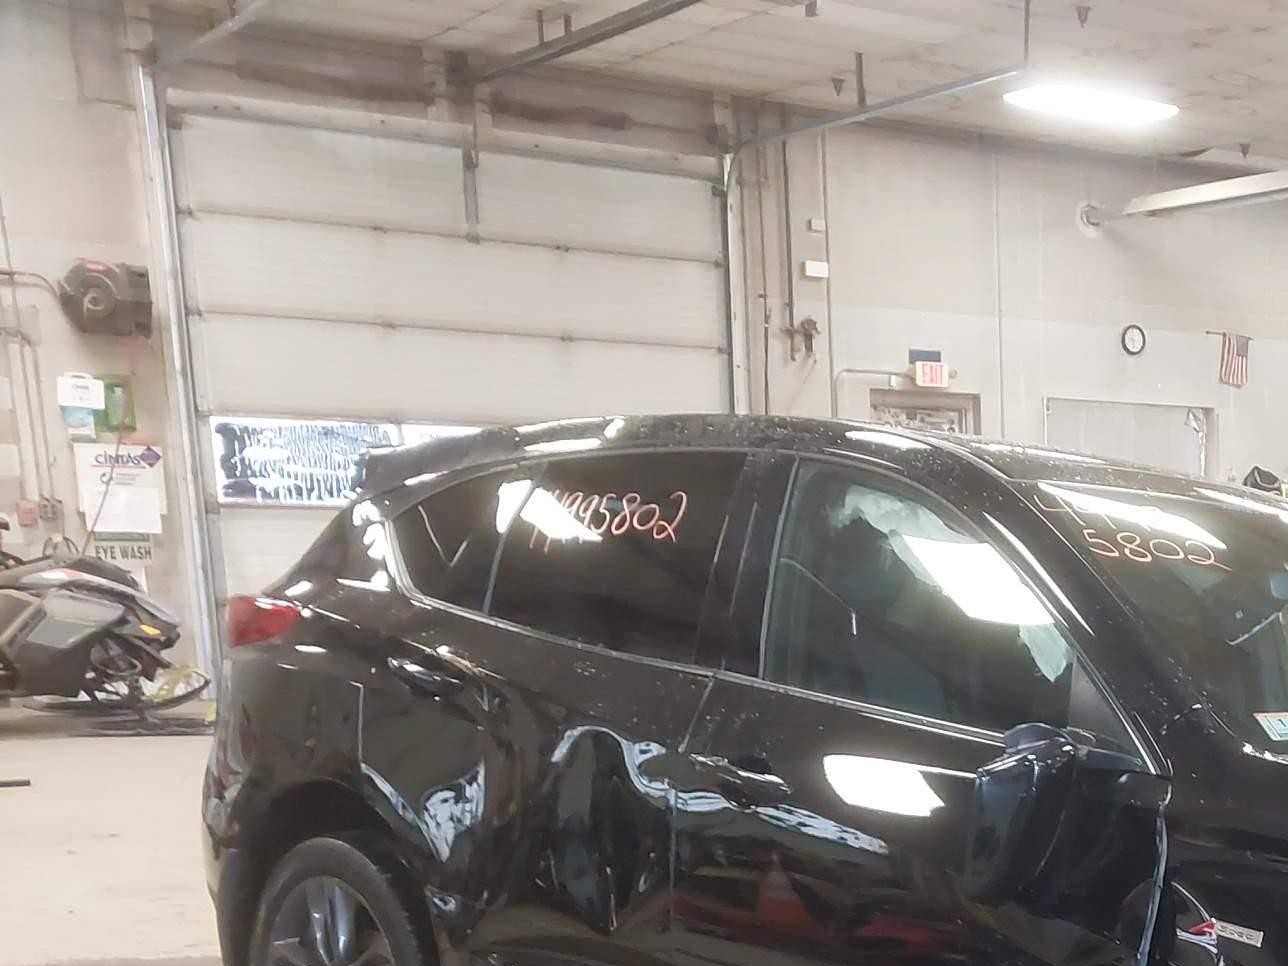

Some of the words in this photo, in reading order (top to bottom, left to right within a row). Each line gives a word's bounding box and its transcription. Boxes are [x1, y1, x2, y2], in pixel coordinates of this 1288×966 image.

[922, 363, 944, 385] EXIT
[95, 546, 117, 560] EYE
[120, 546, 152, 560] WASH
[1082, 528, 1233, 572] 5802
